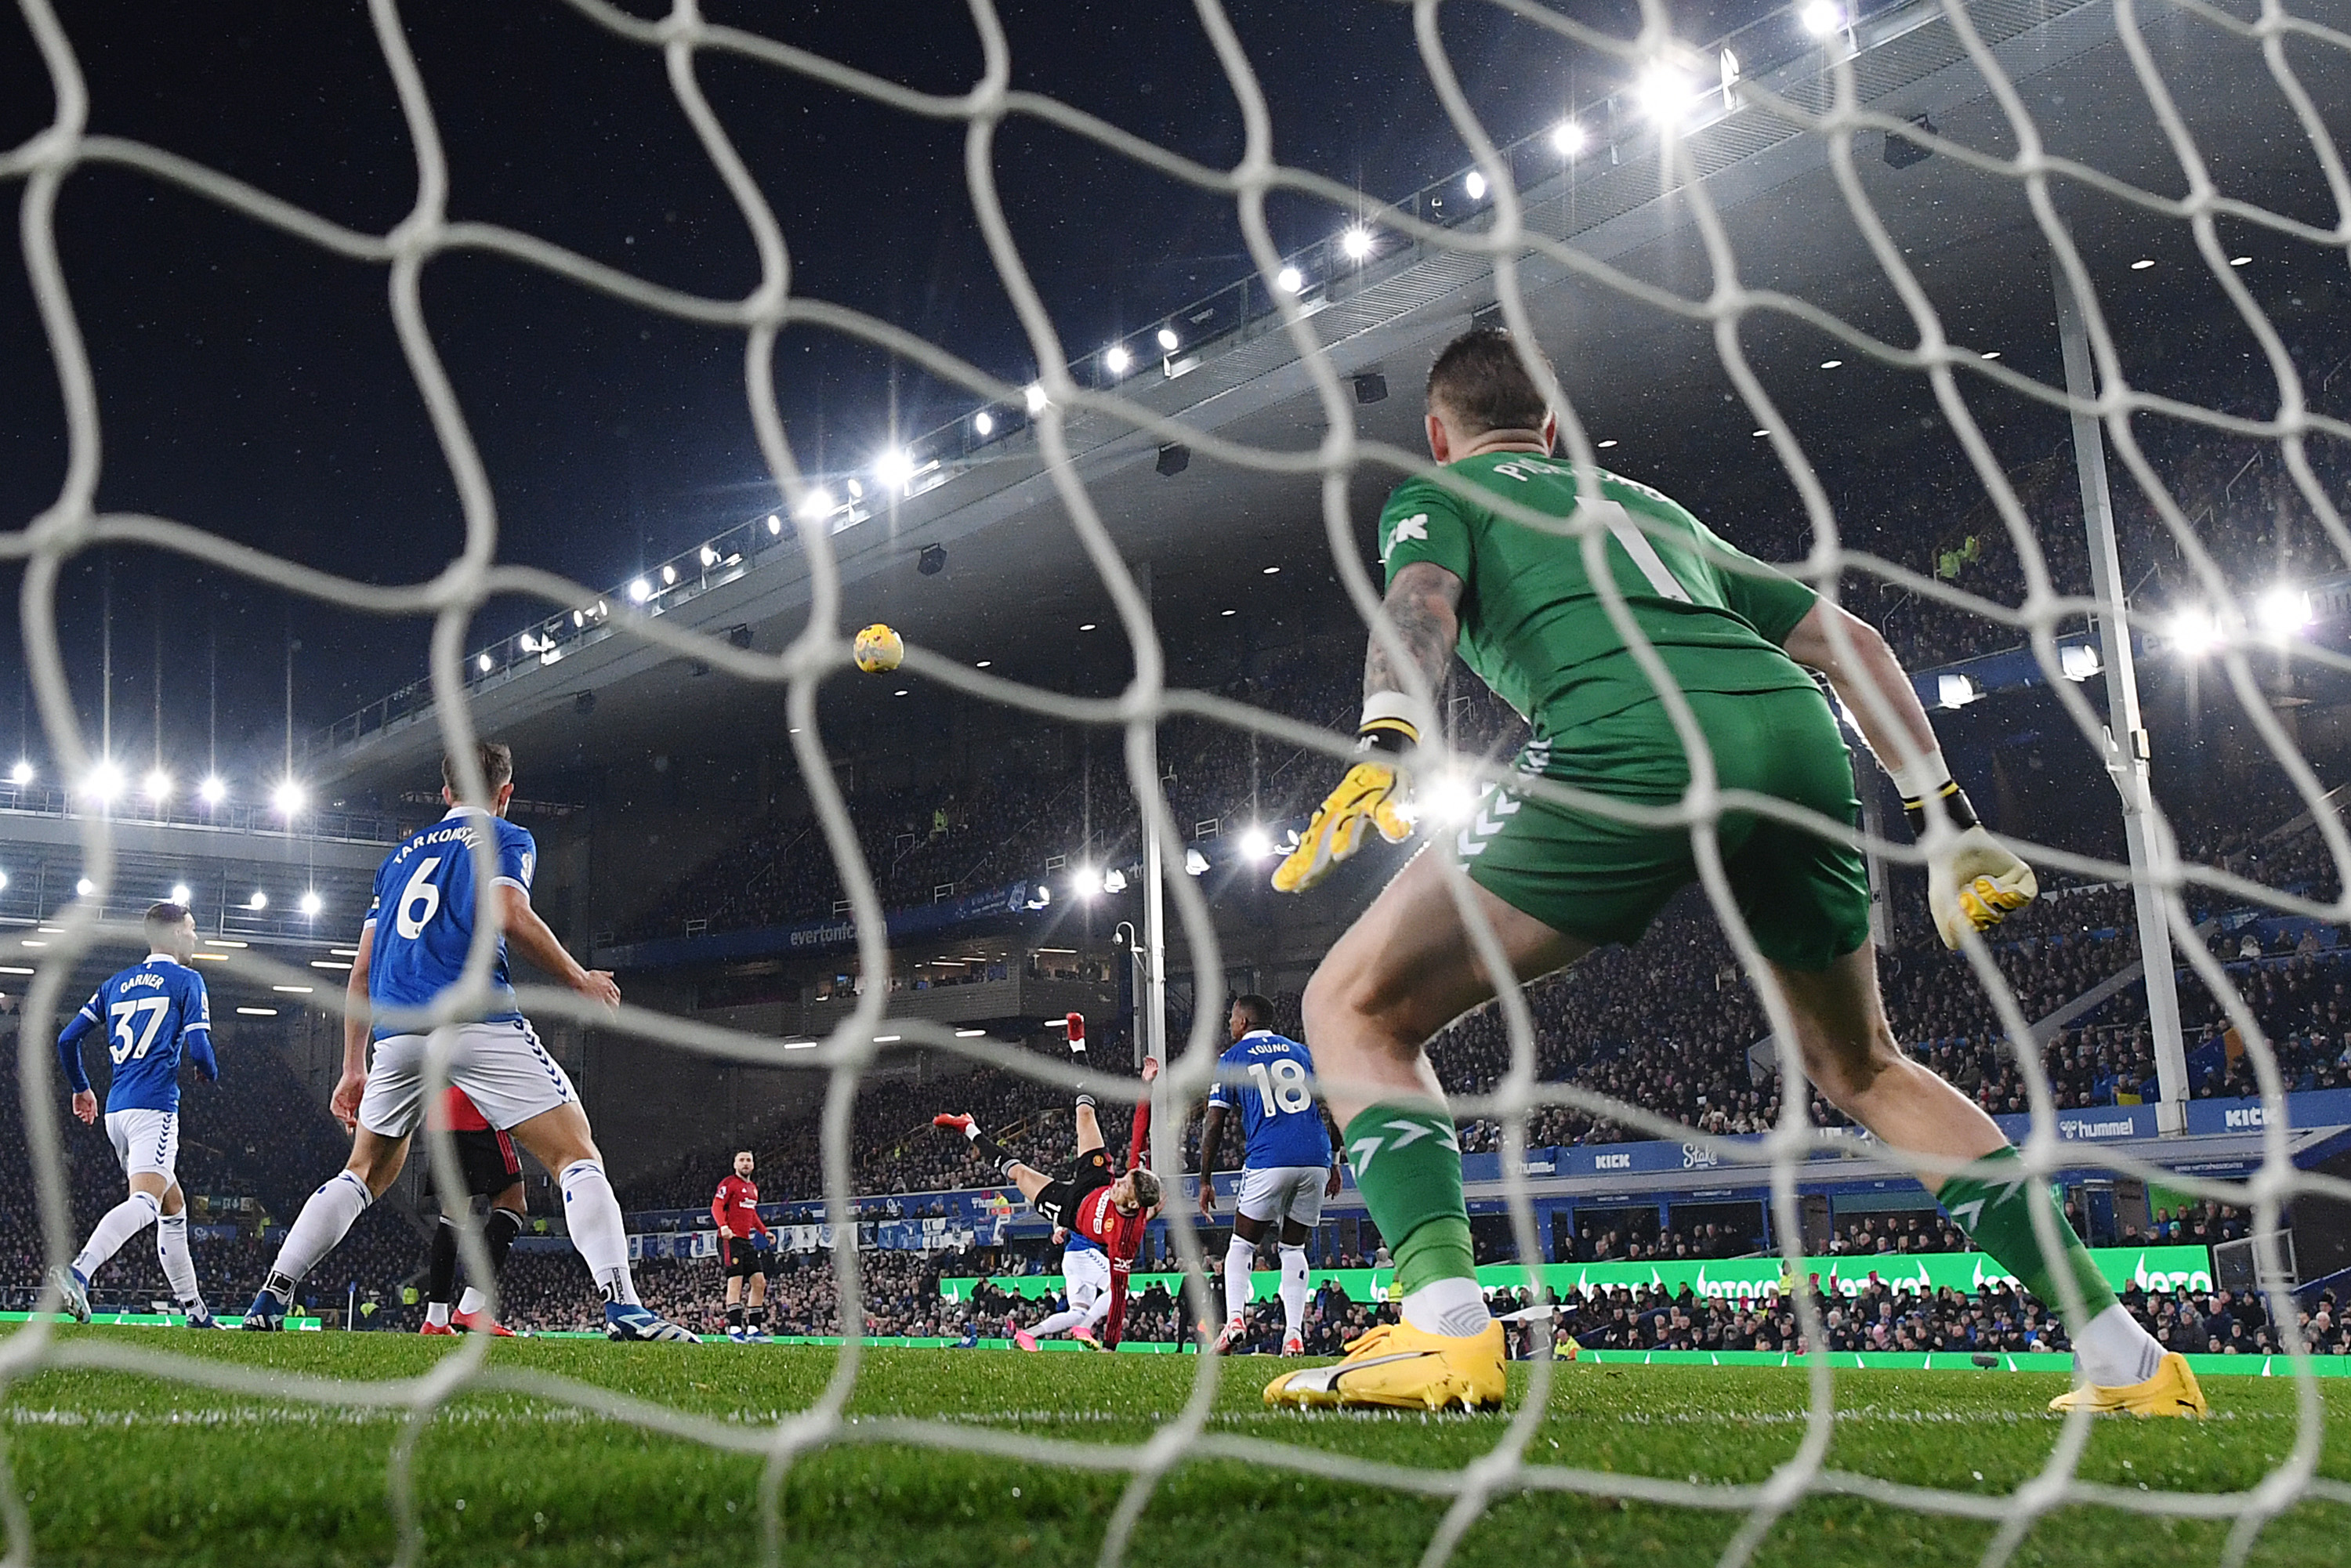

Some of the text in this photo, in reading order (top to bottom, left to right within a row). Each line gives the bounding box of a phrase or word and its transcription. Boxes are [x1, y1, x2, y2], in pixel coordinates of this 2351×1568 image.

[1574, 495, 1693, 604] 1
[397, 856, 441, 940] 6
[121, 973, 164, 993] GARNER
[109, 997, 170, 1064] 37
[1248, 1043, 1290, 1056] YOUNG
[1248, 1059, 1312, 1118] 18
[2078, 1117, 2133, 1138] hummel
[1596, 1153, 1630, 1169] KICK
[1683, 1143, 1718, 1168] Stake
